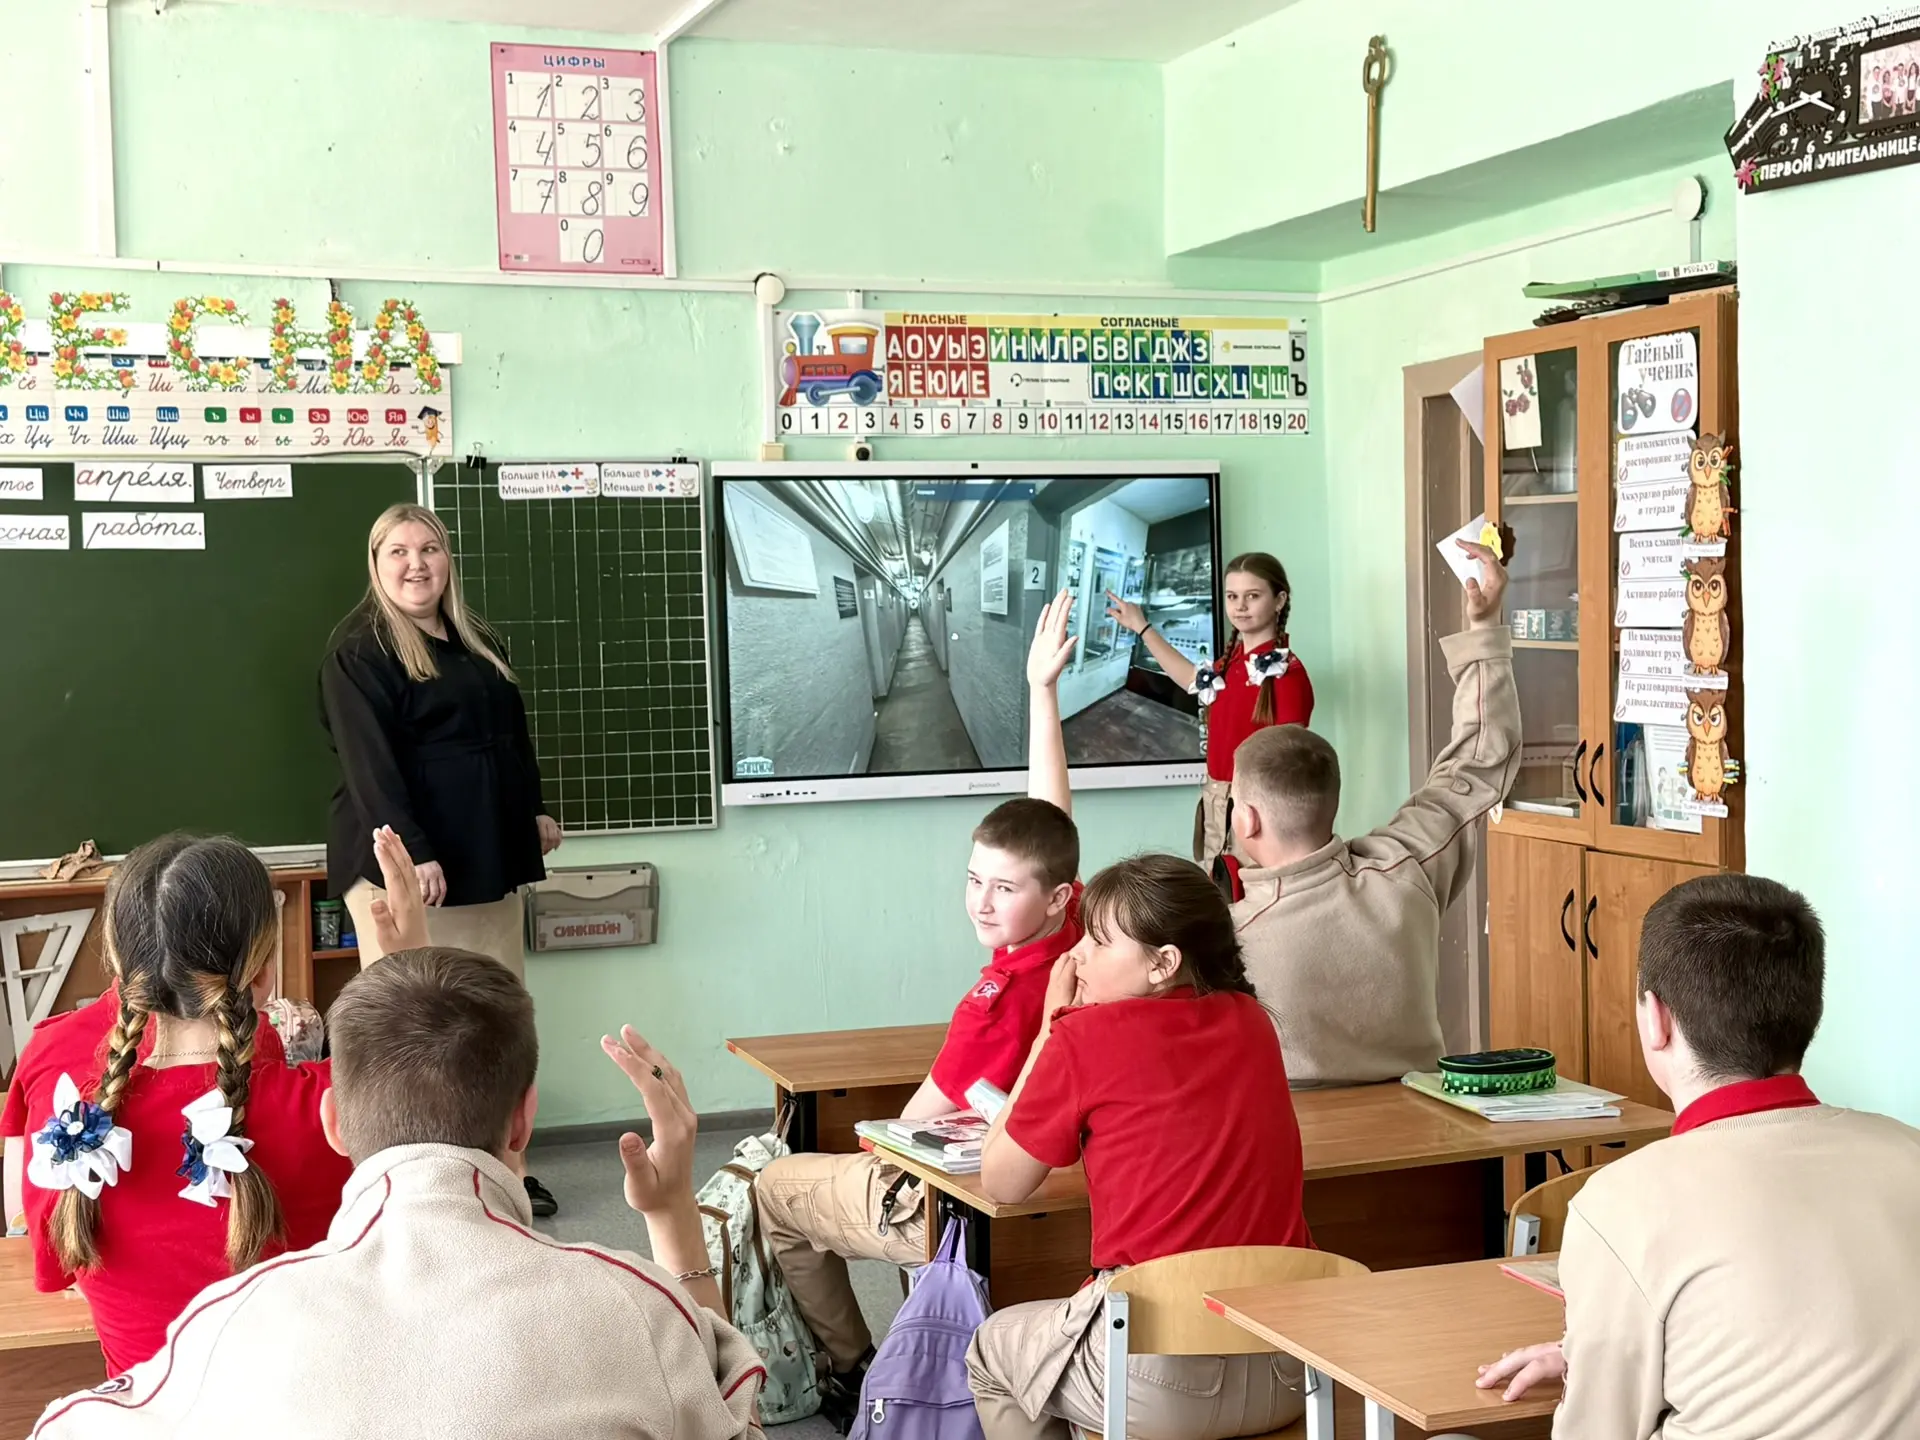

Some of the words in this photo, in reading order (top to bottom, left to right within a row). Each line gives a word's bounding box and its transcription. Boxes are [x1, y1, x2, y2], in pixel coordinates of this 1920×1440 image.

[1810, 46, 1821, 60] 12
[543, 54, 606, 69] ЦИФРЫ
[1795, 55, 1804, 69] 11
[1839, 62, 1848, 76] 2
[507, 73, 514, 84] 1
[555, 76, 563, 87] 2
[603, 78, 610, 89] 3
[1842, 85, 1852, 99] 3
[537, 83, 552, 118] 1
[581, 85, 599, 120] 2
[626, 88, 646, 123] 3
[1836, 110, 1846, 124] 4
[509, 121, 517, 133] 4
[557, 123, 565, 135] 5
[604, 125, 612, 137] 6
[1779, 123, 1788, 137] 8
[1790, 137, 1799, 151] 7
[1823, 130, 1833, 144] 5
[536, 131, 554, 166] 4
[582, 133, 601, 168] 5
[627, 135, 648, 170] 6
[1807, 140, 1816, 154] 6
[1760, 153, 1814, 181] ПЕРВОЙ
[1818, 135, 1916, 170] УЧИТЕЛЬНИЦЕ
[511, 169, 518, 181] 7
[559, 171, 567, 183] 8
[606, 173, 614, 185] 9
[537, 179, 555, 214] 7
[582, 181, 602, 216] 8
[629, 182, 649, 217] 9
[560, 220, 569, 231] 0
[583, 229, 604, 263] 0
[902, 313, 968, 325] ГЛАСНЫЕ
[1100, 316, 1180, 328] СОГЛАСНЫЕ
[887, 334, 903, 360] А
[906, 334, 924, 360] О
[926, 334, 945, 360] У
[948, 334, 966, 361] Ы
[971, 335, 986, 360] Э
[990, 328, 1007, 360] Й
[1011, 335, 1027, 360] Н
[1031, 335, 1048, 360] М
[1050, 337, 1069, 360] Л
[1072, 337, 1088, 361] Р
[1093, 337, 1109, 361] Б
[1113, 337, 1129, 361] В
[1134, 337, 1148, 361] Г
[1152, 338, 1171, 362] Д
[1172, 338, 1191, 361] Ж
[1193, 338, 1207, 361] З
[1291, 339, 1305, 363] Ь
[1624, 339, 1684, 366] Тайный
[889, 371, 903, 394] Я
[909, 364, 924, 395] Ё
[928, 371, 946, 395] Ю
[949, 371, 966, 395] И
[971, 371, 986, 395] Е
[1638, 362, 1694, 386] ученик
[1094, 373, 1109, 396] П
[1113, 373, 1131, 396] Ф
[1135, 373, 1150, 396] К
[1154, 373, 1169, 397] Т
[1173, 373, 1191, 397] Ш
[1194, 373, 1208, 397] С
[1213, 373, 1230, 397] Х
[1232, 373, 1249, 398] Ц
[1253, 373, 1268, 397] Ч
[1271, 373, 1289, 398] Щ
[1290, 373, 1308, 397] Ъ
[28, 408, 47, 421] Цц
[66, 408, 86, 420] Чч
[245, 412, 256, 421] ы
[310, 411, 328, 421] Ээ
[347, 411, 369, 422] Юю
[388, 411, 404, 422] Яя
[781, 412, 792, 430] 0
[811, 412, 819, 429] 1
[838, 412, 849, 429] 2
[865, 412, 876, 429] 3
[889, 412, 899, 429] 4
[913, 413, 924, 430] 5
[941, 413, 951, 430] 6
[967, 413, 977, 429] 7
[992, 413, 1003, 430] 8
[1018, 413, 1029, 430] 9
[1039, 413, 1058, 430] 10
[1065, 413, 1083, 430] 11
[1089, 413, 1109, 430] 12
[1114, 414, 1134, 430] 13
[1139, 414, 1159, 430] 14
[1164, 414, 1184, 430] 15
[1189, 414, 1209, 430] 16
[1214, 414, 1233, 430] 17
[1239, 414, 1258, 430] 18
[1263, 414, 1282, 430] 19
[1287, 414, 1307, 430] 20
[24, 425, 55, 449] Цц
[102, 425, 139, 445] Шш
[149, 425, 190, 450] Щщ
[311, 427, 330, 446] Ээ
[342, 427, 375, 446] Юю
[384, 427, 409, 447] Яя
[500, 471, 540, 481] Больше
[541, 470, 557, 480] НА
[603, 469, 641, 478] Больше
[643, 469, 651, 478] В
[215, 471, 286, 496] Четверг
[501, 484, 544, 494] Меньше
[546, 484, 561, 494] НА
[603, 483, 645, 493] Меньше
[647, 484, 654, 492] В
[1031, 566, 1040, 584] 2
[553, 920, 621, 938] СИНКВЕЙН
